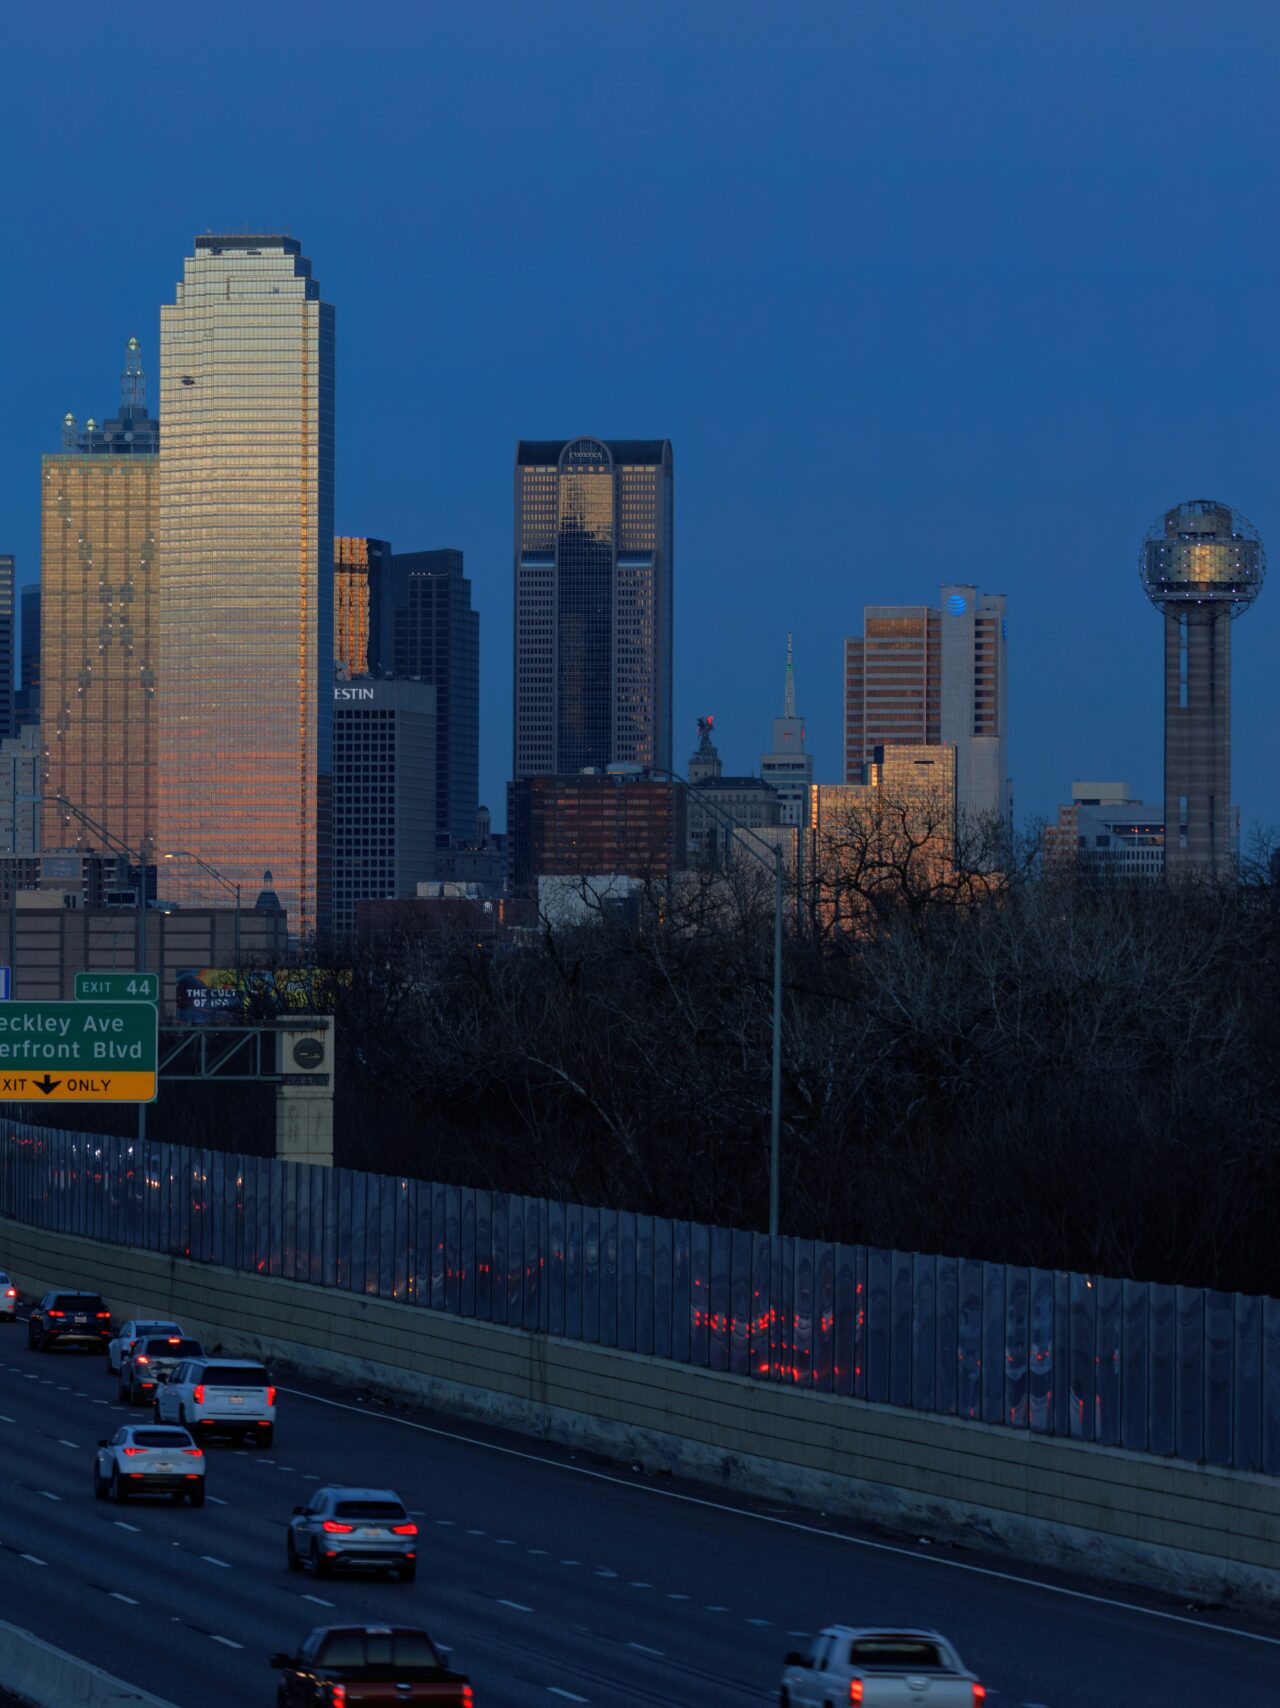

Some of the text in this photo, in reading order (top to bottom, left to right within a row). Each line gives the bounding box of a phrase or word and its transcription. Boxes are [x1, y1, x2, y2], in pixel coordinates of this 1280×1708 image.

[333, 688, 374, 700] ESTIN
[82, 979, 151, 995] EXIT 44
[186, 989, 236, 998] THE CULT
[193, 999, 208, 1008] OF
[82, 1015, 124, 1032] Ave
[94, 1041, 142, 1058] Blvd
[67, 1079, 111, 1091] ONLY
